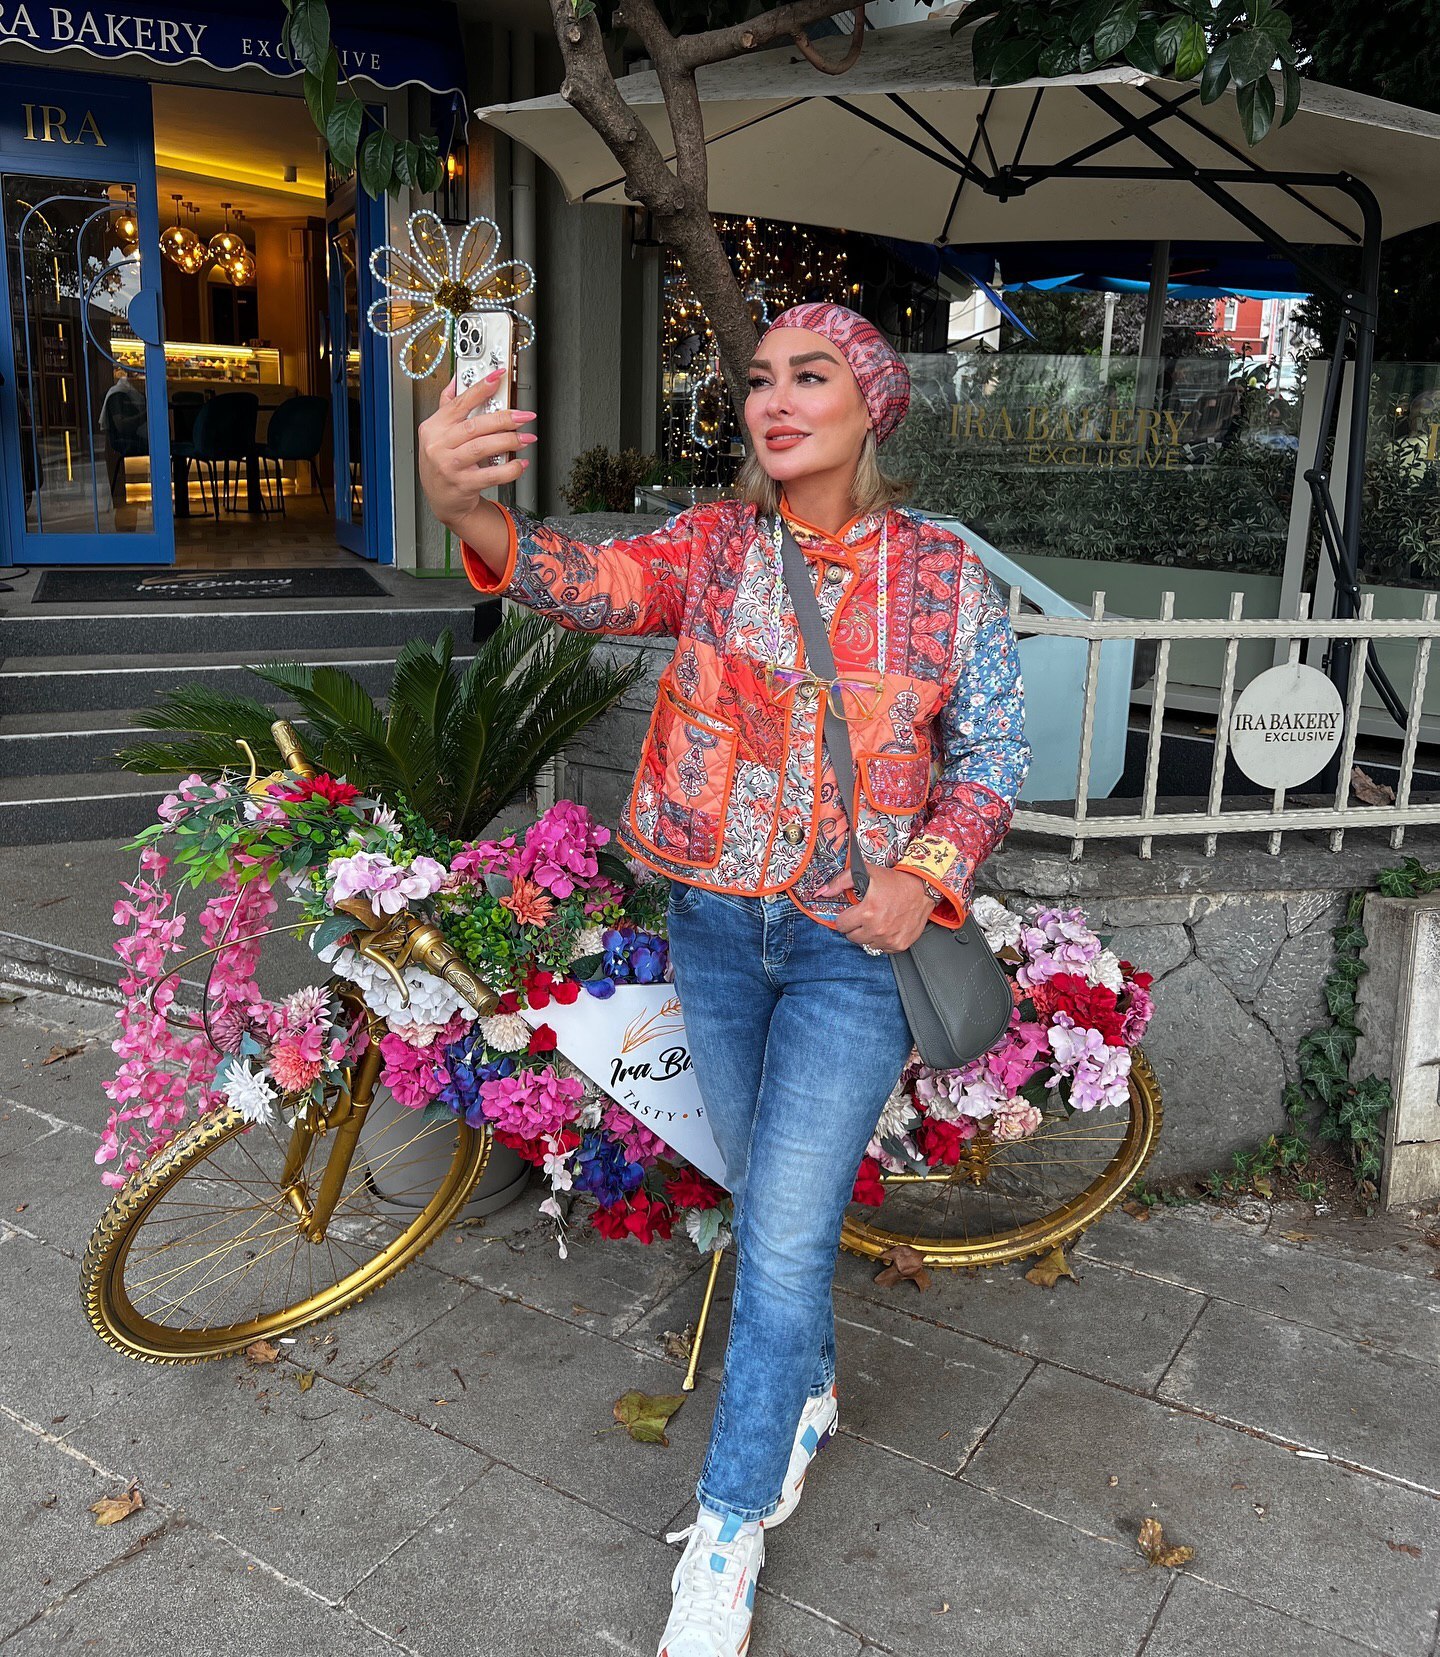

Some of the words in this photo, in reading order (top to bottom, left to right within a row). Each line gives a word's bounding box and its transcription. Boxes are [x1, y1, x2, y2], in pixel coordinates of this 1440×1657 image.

[49, 7, 208, 55] BAKERY
[241, 38, 381, 70] EXCIVE
[21, 103, 107, 147] IRA
[949, 403, 1015, 439] IRA
[1025, 405, 1191, 446] BAKERY
[1028, 445, 1180, 470] EXCLUSIVE
[1234, 713, 1266, 731] IRA
[1270, 712, 1340, 730] BAKERY
[1265, 731, 1334, 742] EXCLUSIVE
[610, 1057, 652, 1088] Ira
[624, 1090, 676, 1121] TASTY
